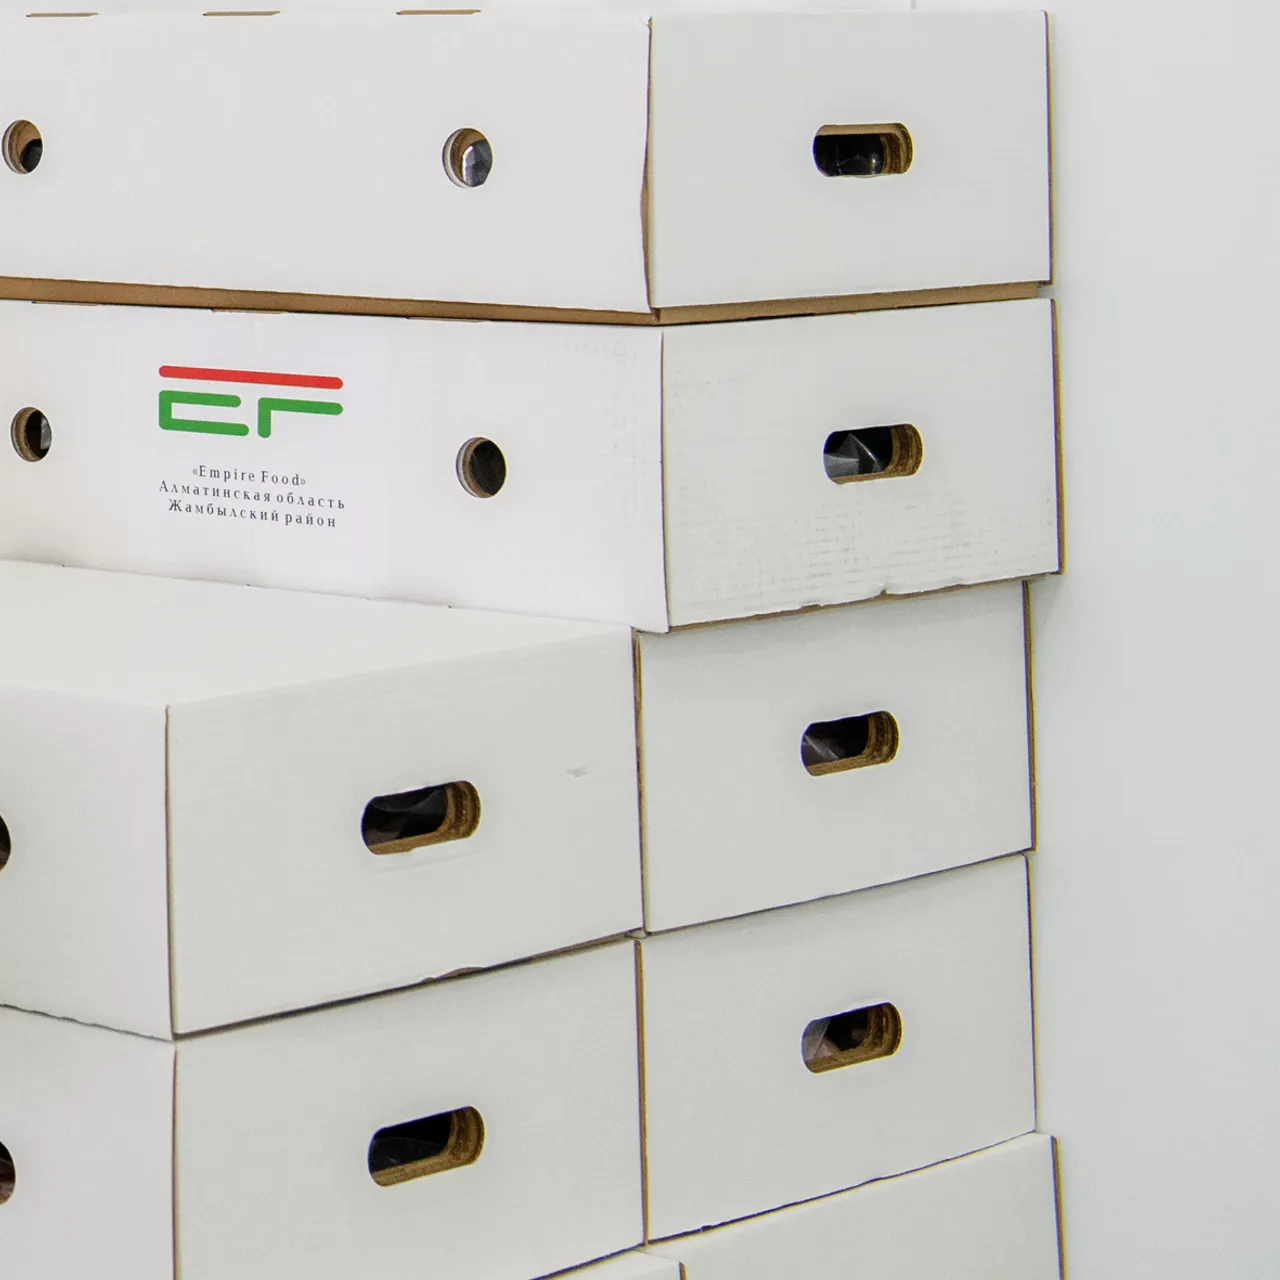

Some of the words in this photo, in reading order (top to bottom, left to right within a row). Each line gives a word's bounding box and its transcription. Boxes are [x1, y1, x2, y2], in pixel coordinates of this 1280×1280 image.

[192, 464, 256, 483] «Empire
[260, 470, 307, 487] Food»
[158, 479, 271, 503] Алматинская
[276, 491, 345, 510] область
[168, 498, 279, 522] Жамбылский
[284, 511, 336, 528] район
